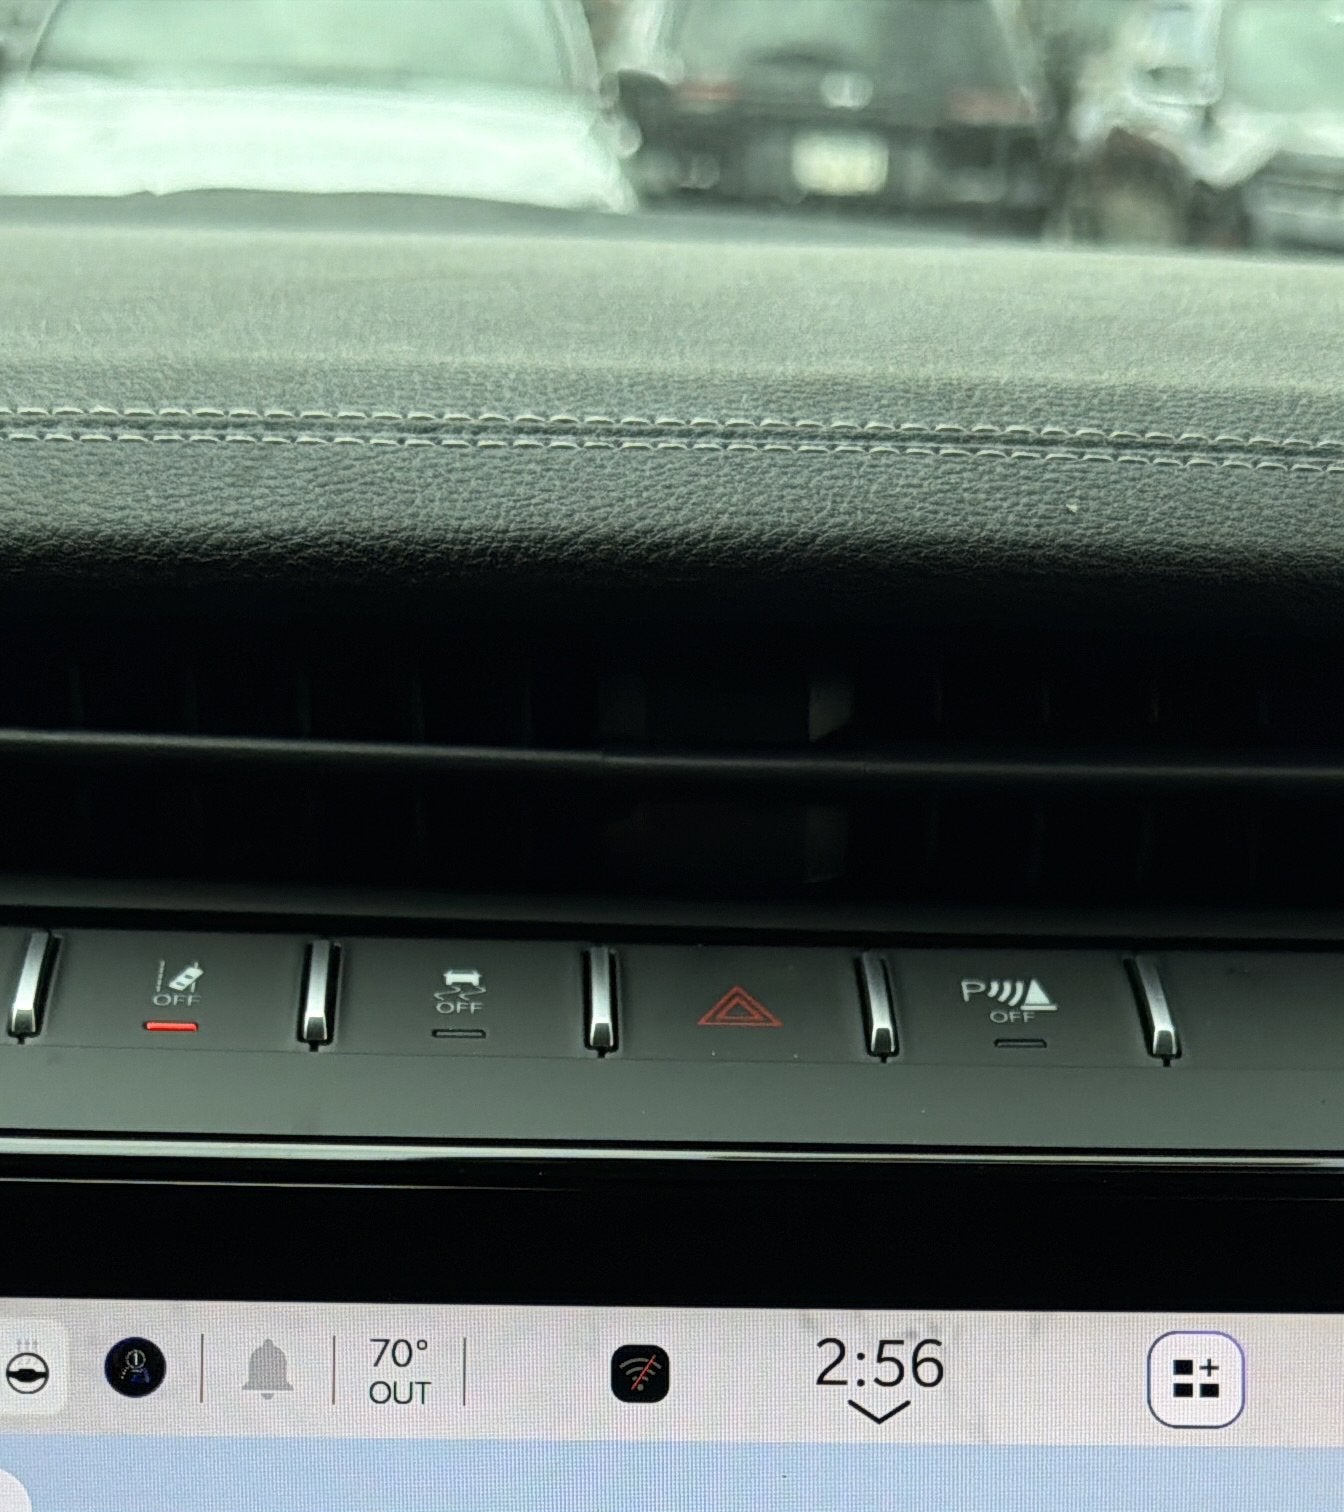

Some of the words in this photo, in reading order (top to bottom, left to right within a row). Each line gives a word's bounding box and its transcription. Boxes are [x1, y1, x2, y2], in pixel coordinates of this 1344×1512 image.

[151, 991, 201, 1006] OFF
[434, 999, 482, 1014] OFF
[988, 1008, 1035, 1023] OFF
[815, 1337, 944, 1388] 2:56
[368, 1380, 432, 1405] OUT
